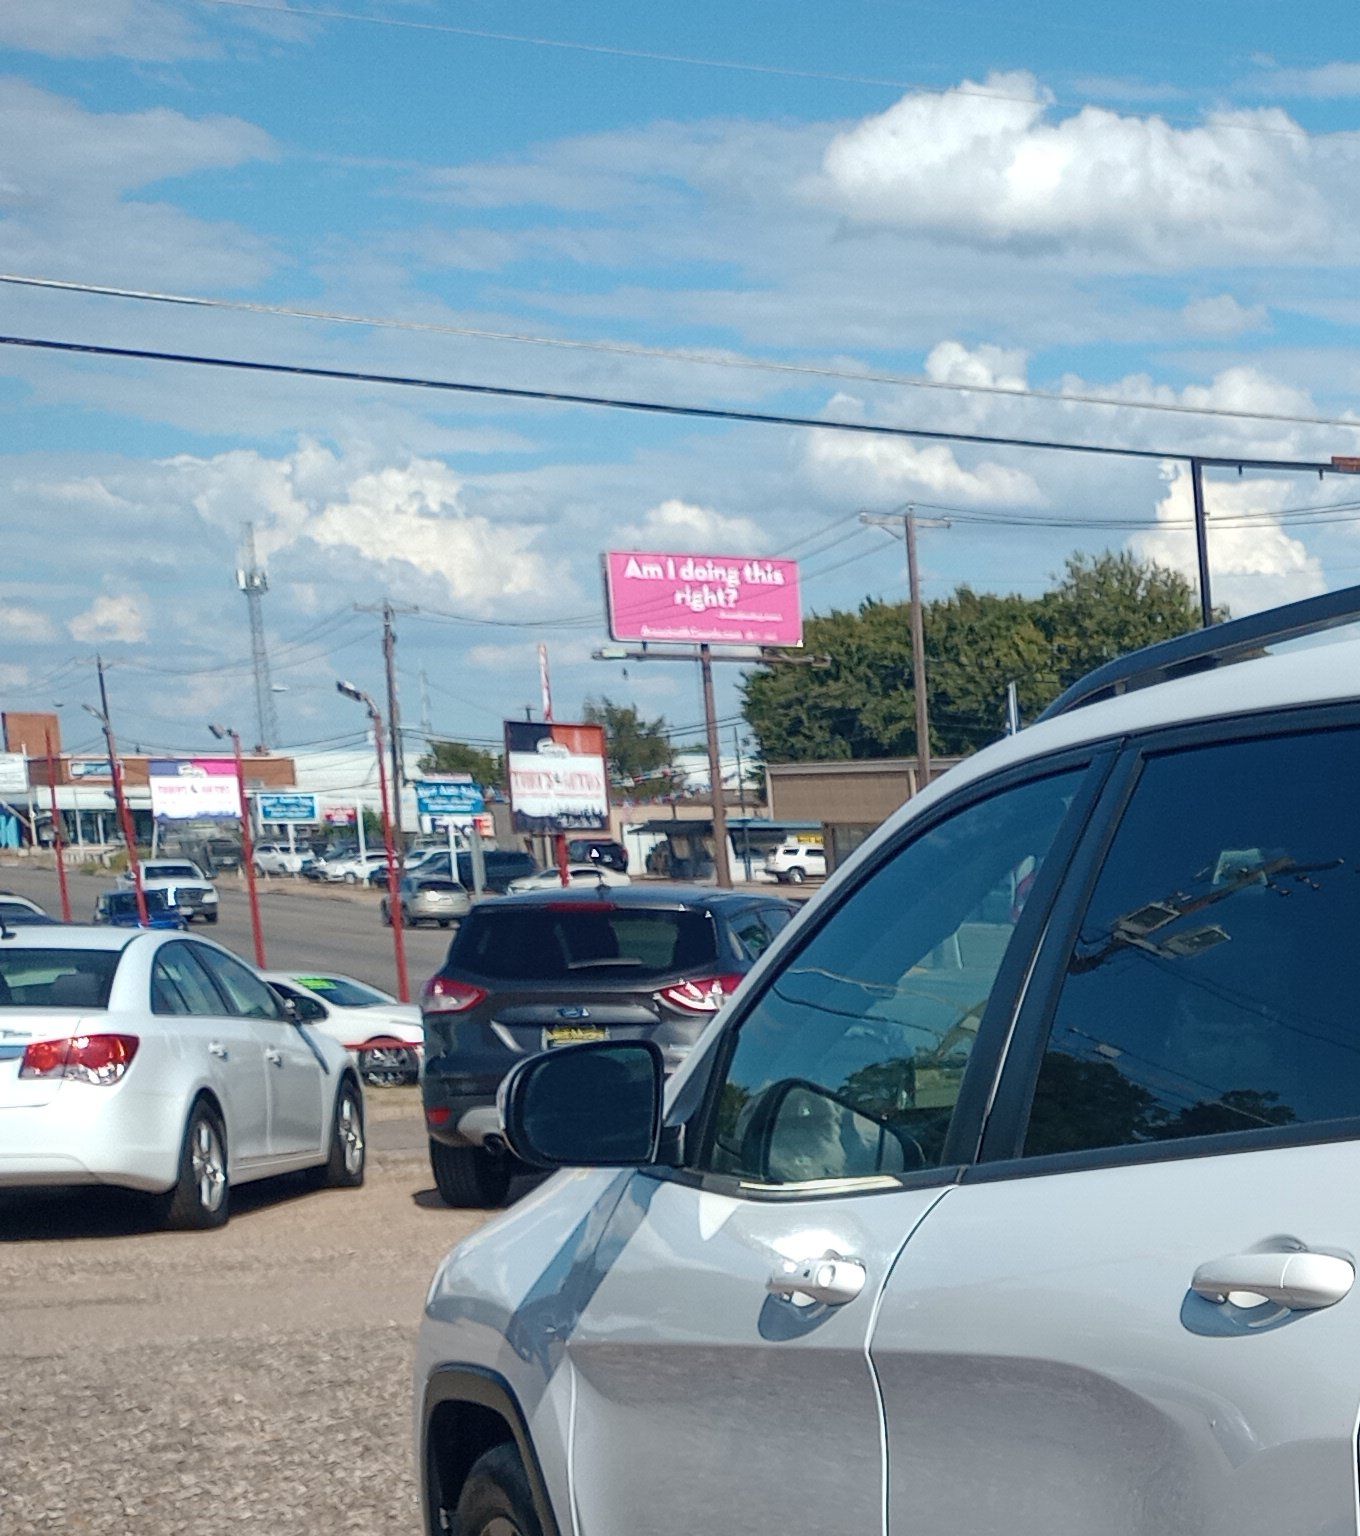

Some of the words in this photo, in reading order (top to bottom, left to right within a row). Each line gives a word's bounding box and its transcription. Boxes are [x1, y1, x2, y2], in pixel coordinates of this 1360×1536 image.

[624, 557, 664, 580] Am
[667, 558, 675, 581] I
[680, 558, 740, 587] doing
[743, 561, 785, 585] this
[674, 584, 738, 612] right?
